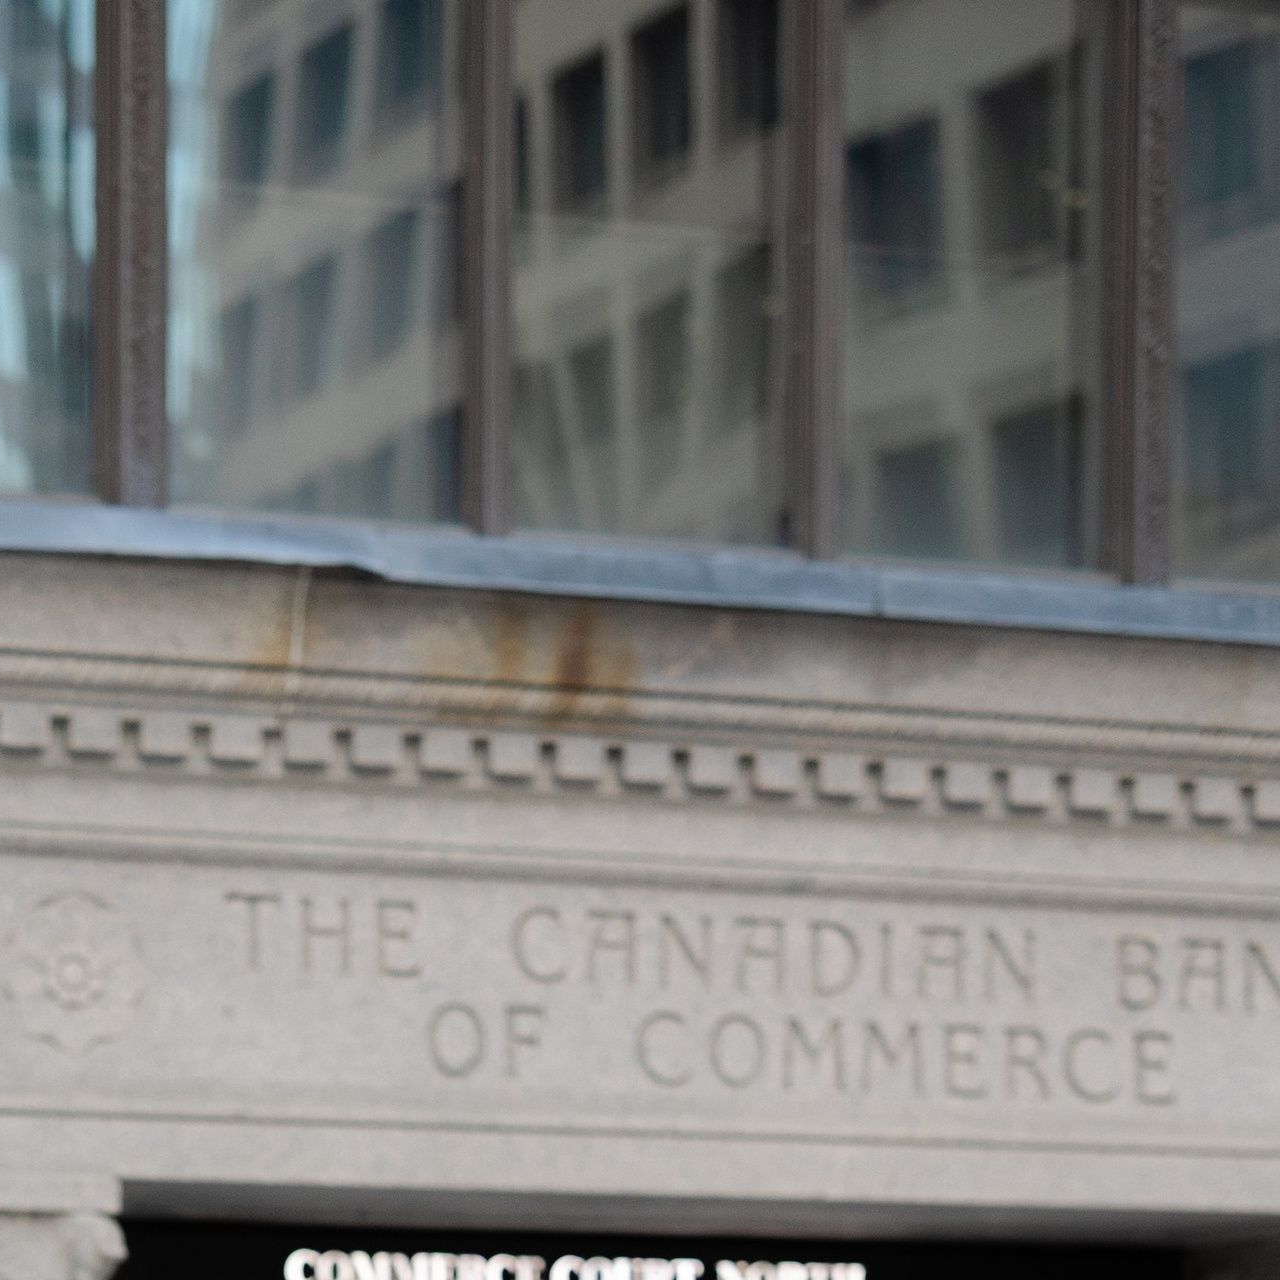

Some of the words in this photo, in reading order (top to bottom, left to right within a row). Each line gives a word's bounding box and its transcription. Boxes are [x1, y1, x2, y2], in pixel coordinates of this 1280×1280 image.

[222, 890, 423, 978] THE
[509, 904, 1038, 1003] CANADIAN
[426, 1002, 546, 1080] OF
[634, 1008, 1180, 1107] COMMERCE
